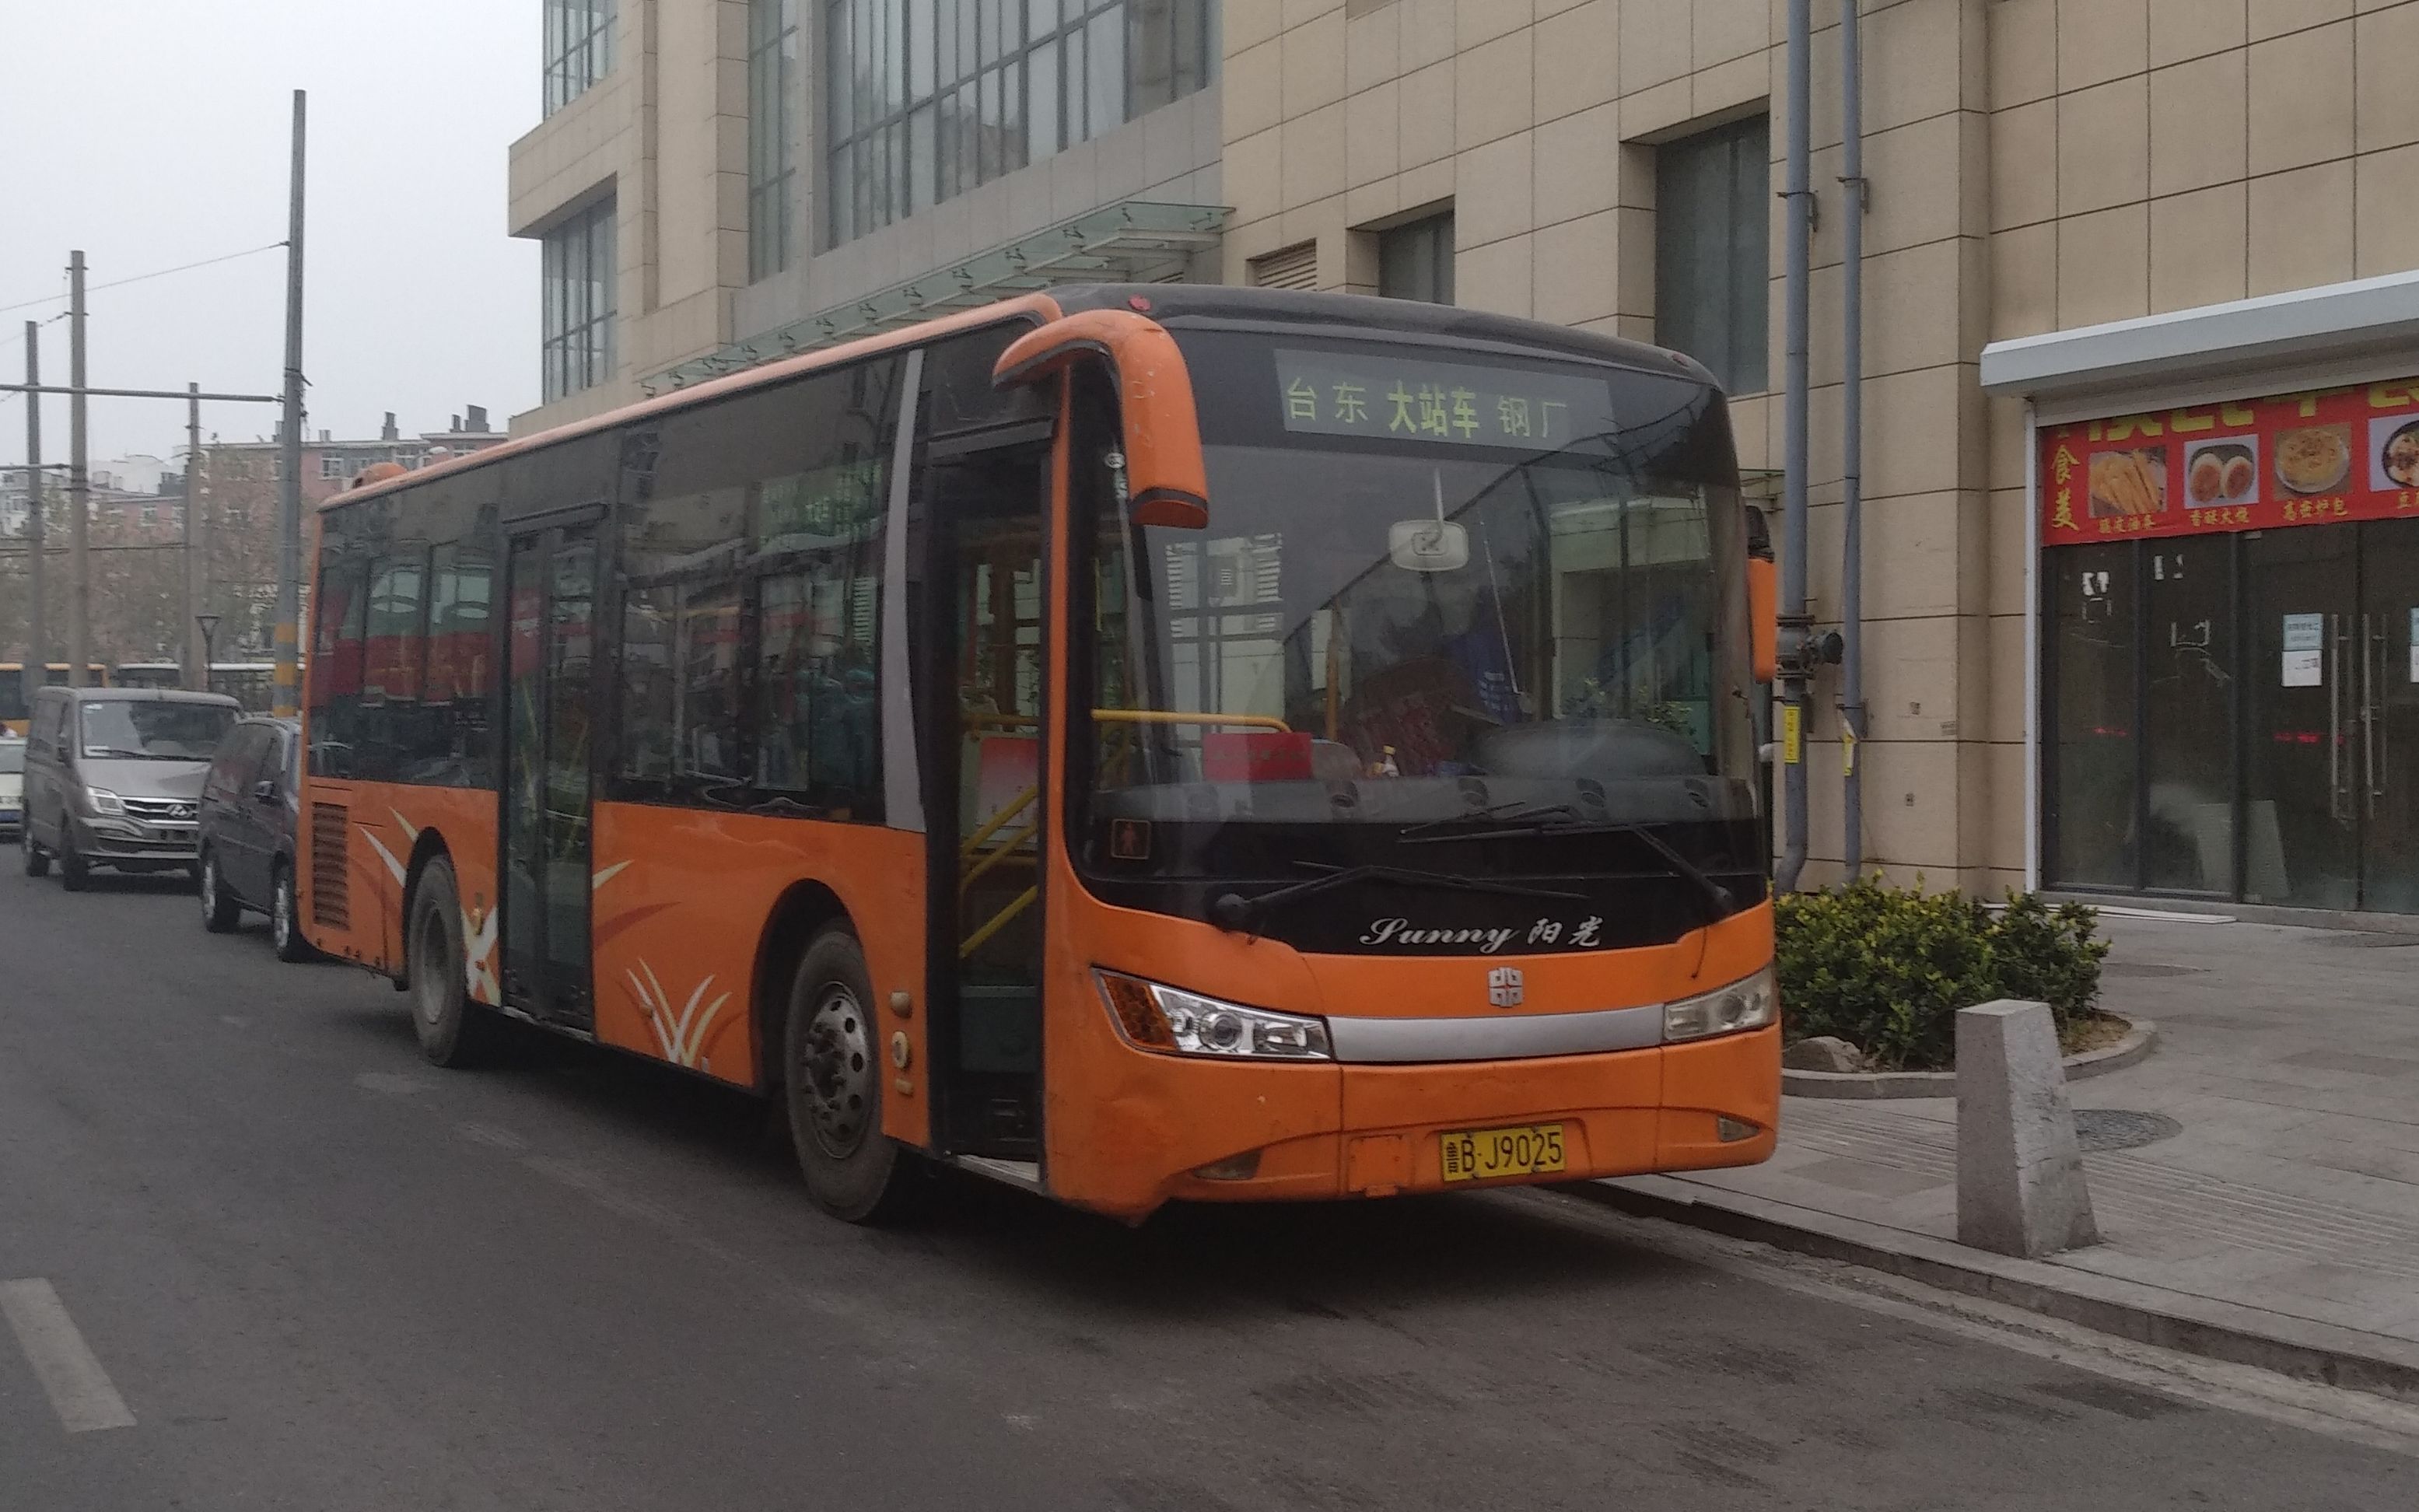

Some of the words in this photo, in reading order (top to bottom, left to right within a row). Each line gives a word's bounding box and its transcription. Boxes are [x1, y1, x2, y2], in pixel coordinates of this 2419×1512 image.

[1287, 376, 1369, 425] 台东
[1387, 380, 1479, 439] 大站车
[1497, 395, 1567, 437] 钢厂
[1359, 919, 1520, 954] Sunny
[1527, 916, 1602, 947] 阳光
